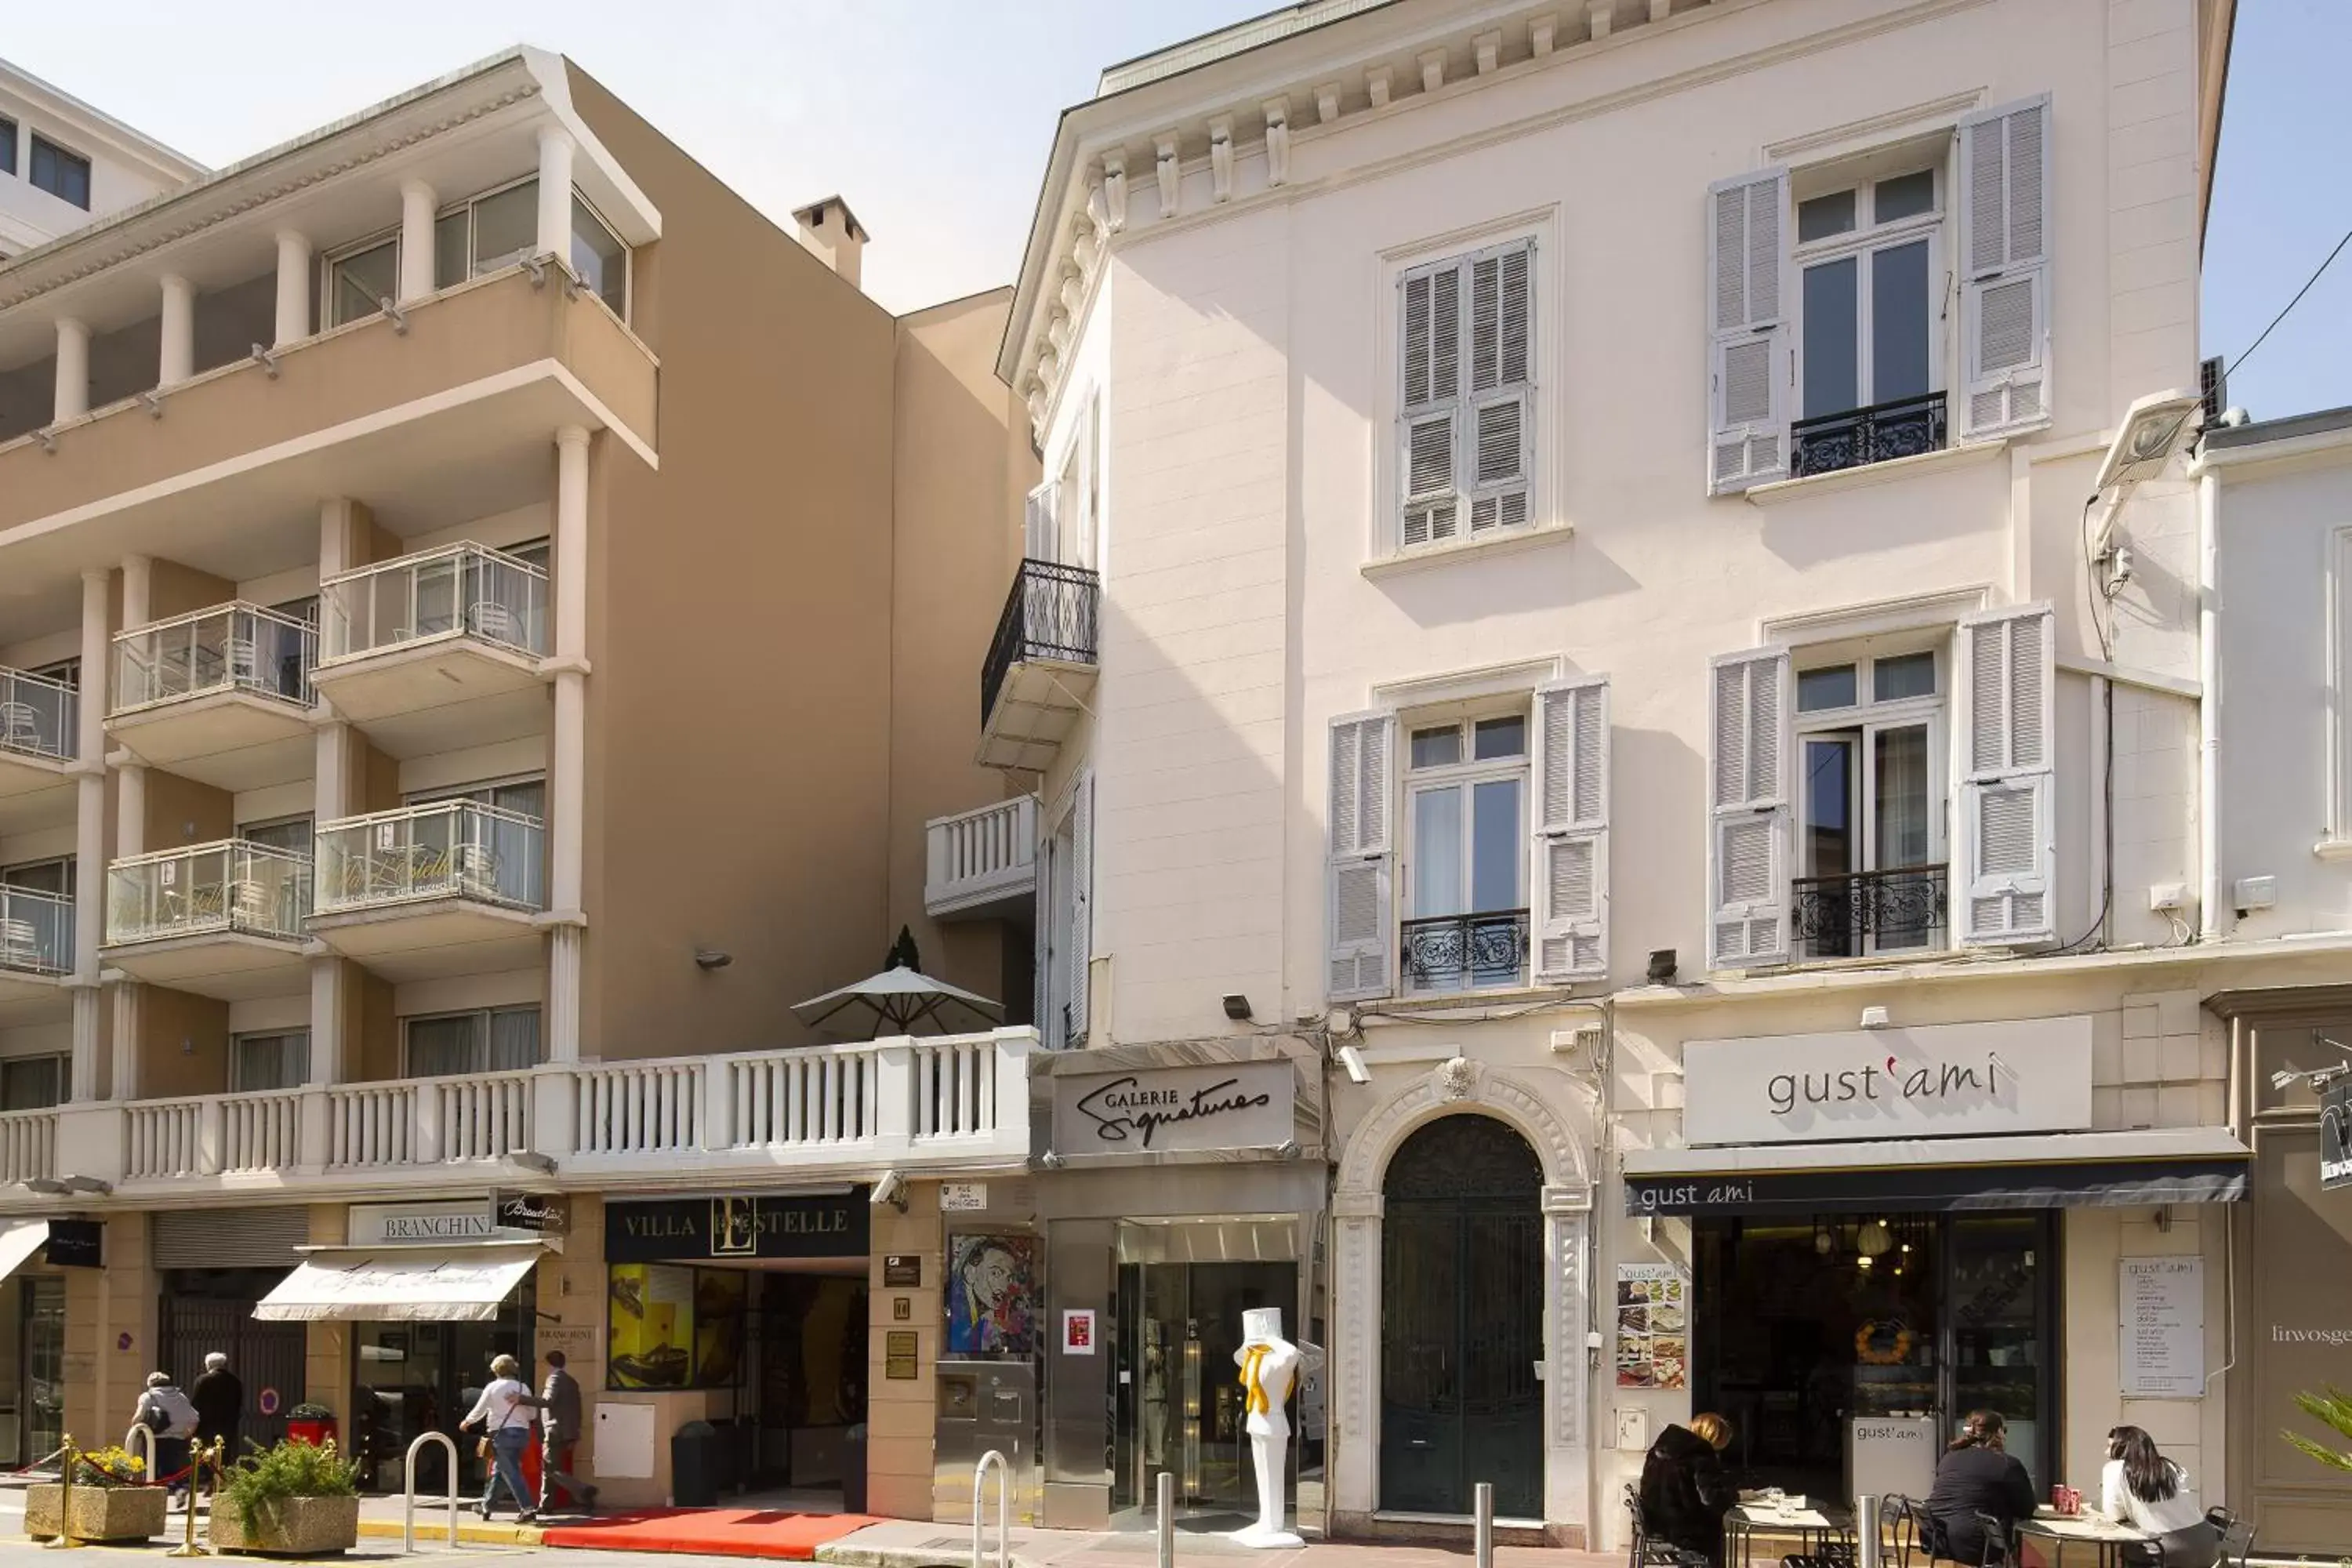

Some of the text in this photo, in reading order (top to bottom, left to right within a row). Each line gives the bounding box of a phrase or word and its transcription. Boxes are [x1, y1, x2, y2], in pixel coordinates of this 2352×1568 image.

[1105, 1089, 1179, 1108] GALERIE
[1077, 1076, 1270, 1148] Signatures
[1641, 1180, 1754, 1210] gust ami
[625, 1214, 696, 1236] VILLA
[1857, 1427, 1923, 1440] gust'ami
